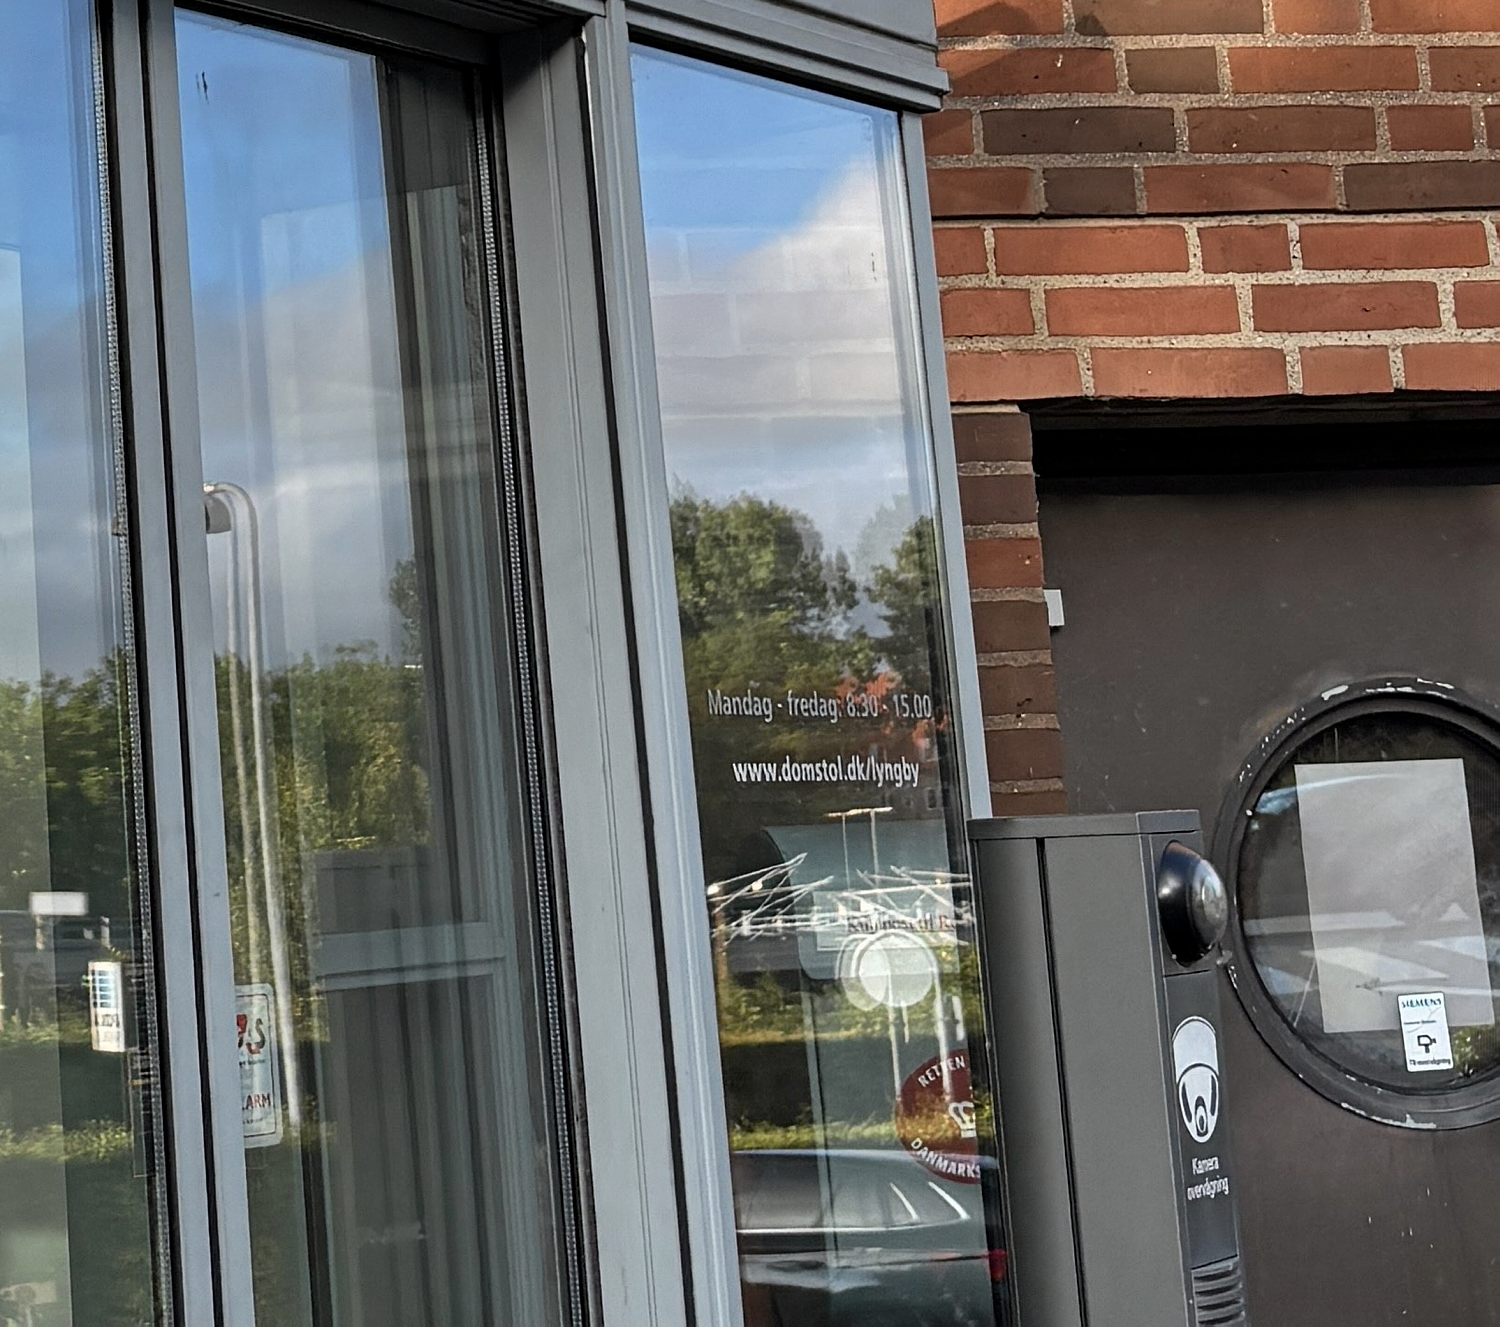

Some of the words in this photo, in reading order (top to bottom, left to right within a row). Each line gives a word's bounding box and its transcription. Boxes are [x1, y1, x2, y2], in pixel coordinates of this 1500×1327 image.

[707, 689, 773, 723] Mandag
[893, 694, 932, 719] 15.00
[733, 755, 920, 788] www.domstol.dk/lyngby
[242, 1092, 272, 1111] ARM
